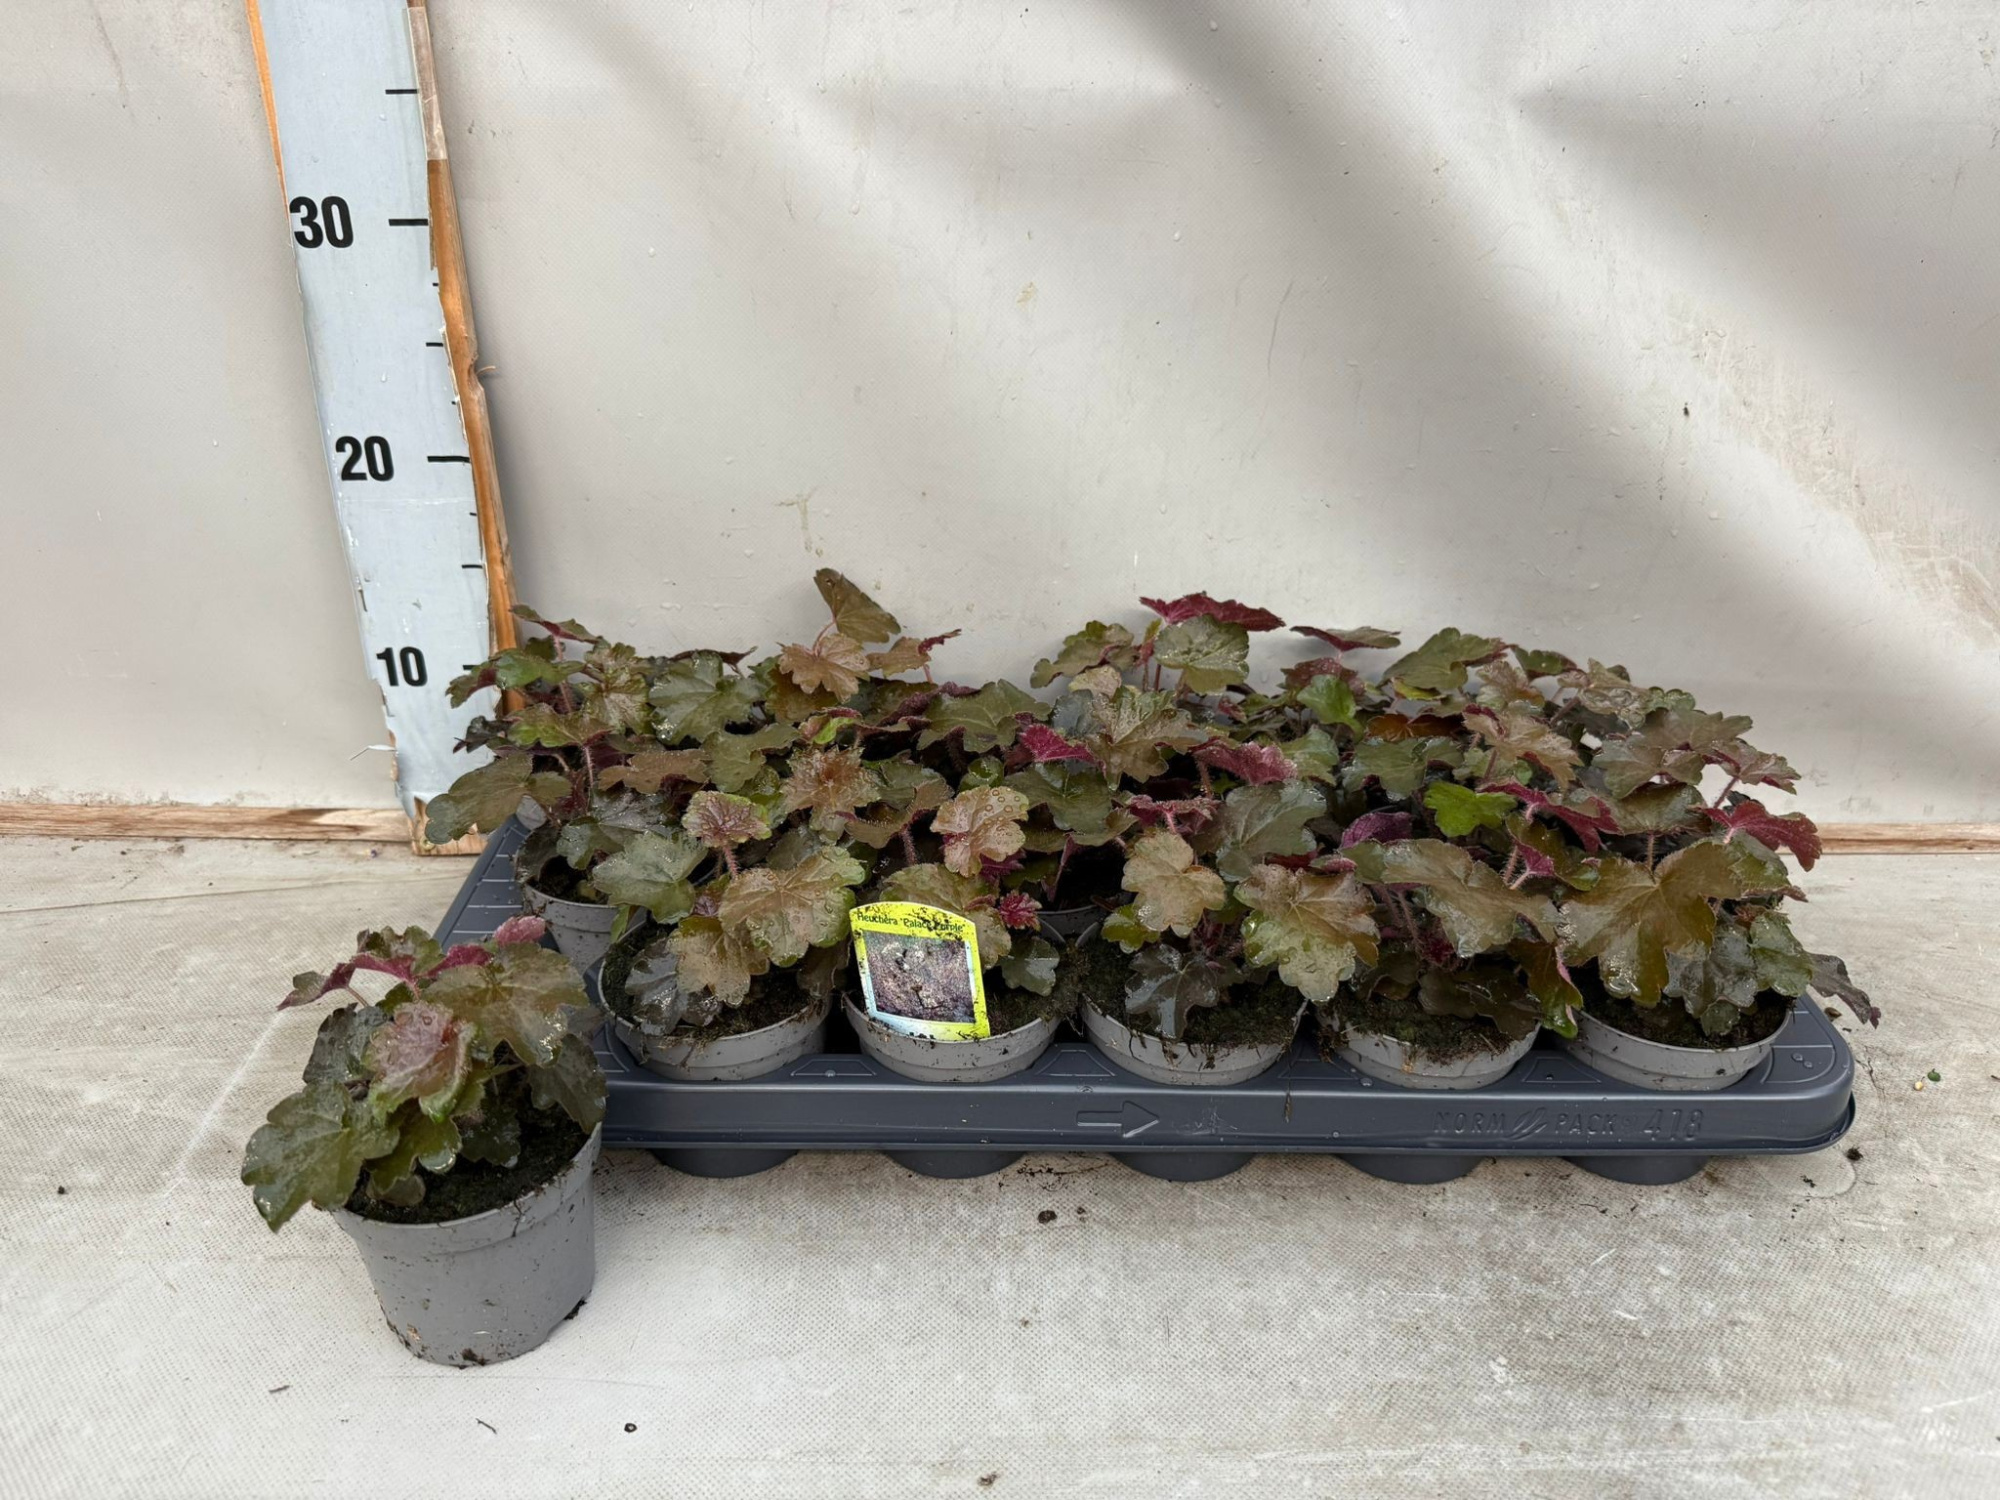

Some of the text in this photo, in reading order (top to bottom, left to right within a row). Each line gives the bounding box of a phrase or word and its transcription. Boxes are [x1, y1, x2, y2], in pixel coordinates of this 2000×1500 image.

[289, 195, 354, 249] 30
[335, 435, 395, 482] 20
[376, 646, 428, 688] 10
[1433, 1111, 1506, 1134] NORM
[1642, 1108, 1704, 1141] 418
